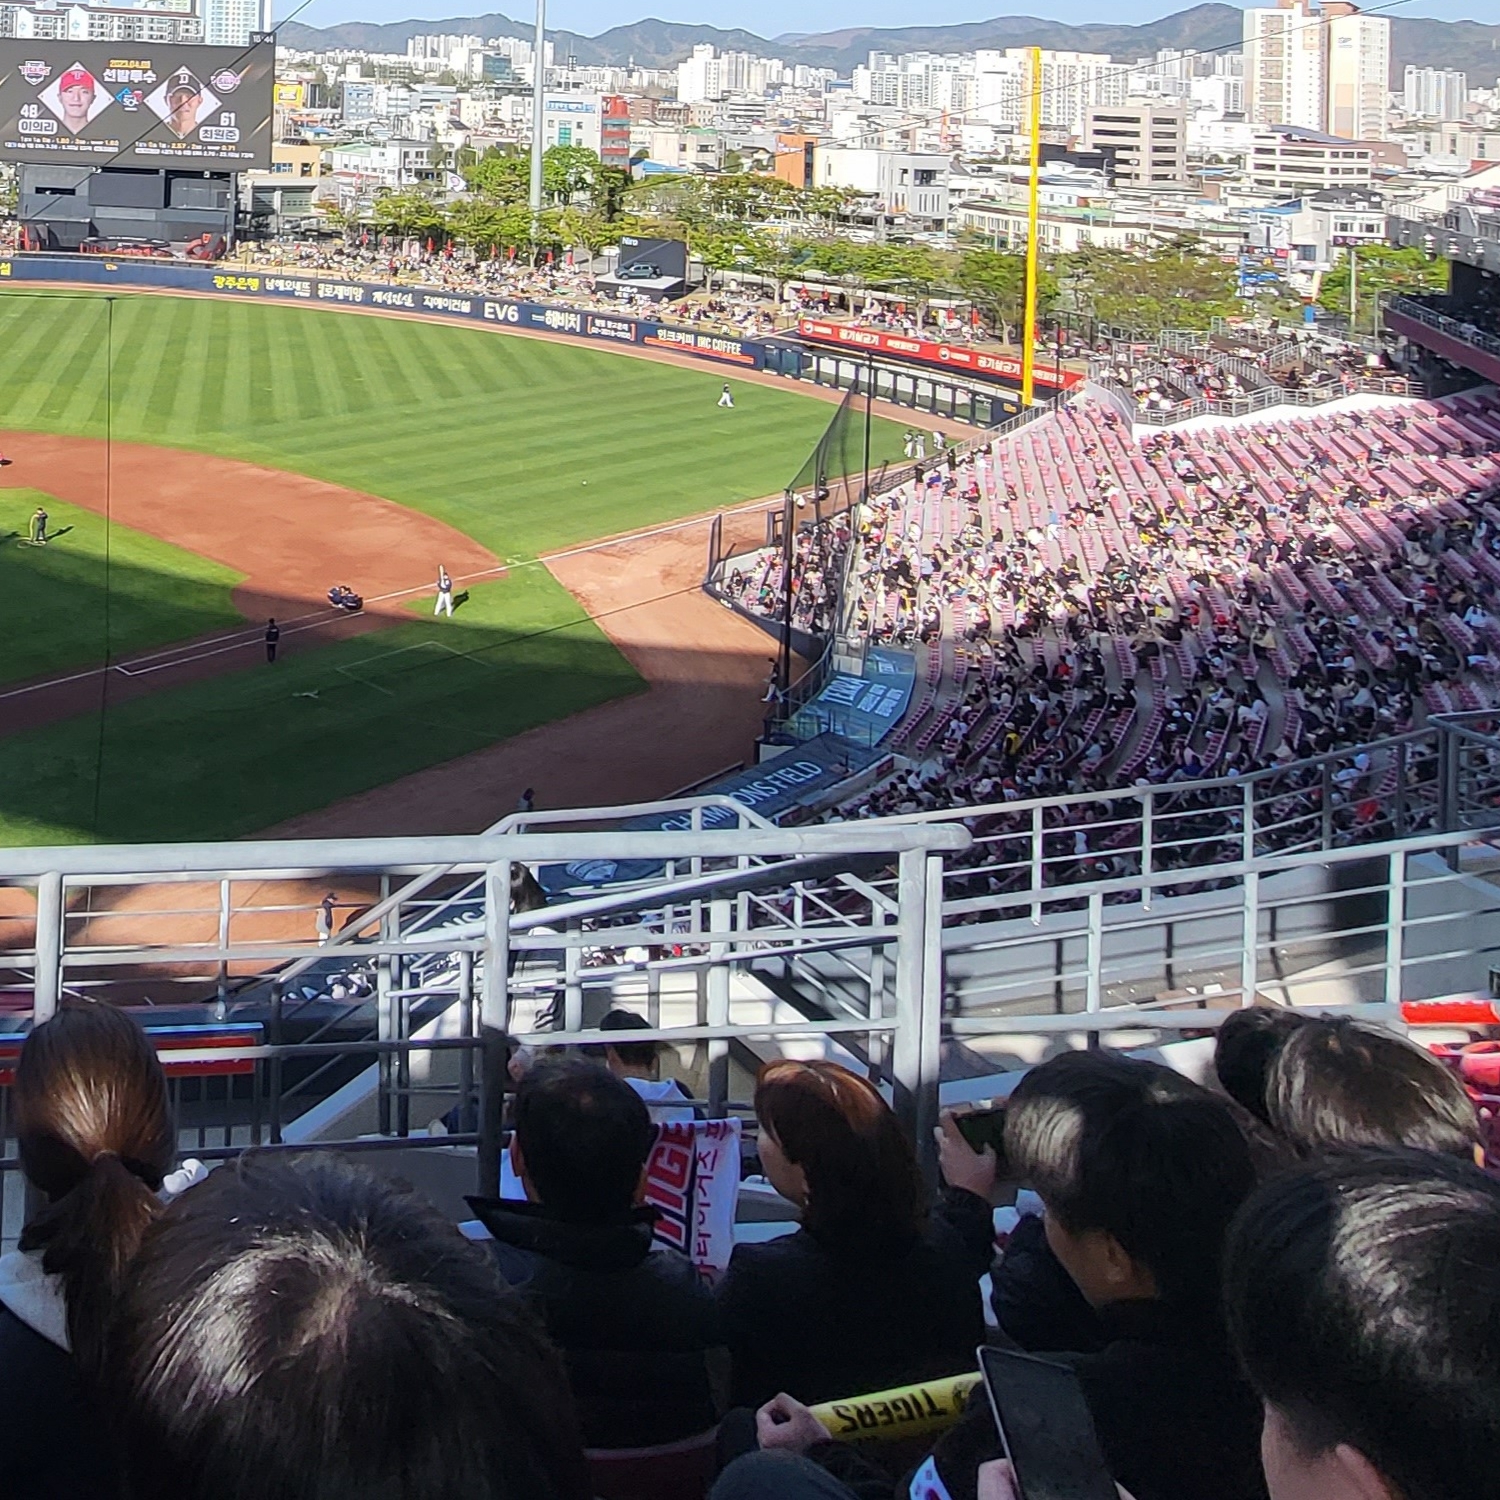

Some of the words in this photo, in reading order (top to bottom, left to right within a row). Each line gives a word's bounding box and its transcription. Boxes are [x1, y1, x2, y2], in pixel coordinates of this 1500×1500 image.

[102, 68, 157, 84] 선발투수
[20, 103, 39, 118] 48
[21, 120, 55, 133] 이의리
[219, 112, 236, 127] 61
[201, 128, 237, 141] 최원준
[622, 237, 639, 246] Niro
[212, 275, 260, 291] 광주은행
[483, 300, 520, 323] EV6
[544, 309, 581, 333] 해비치
[657, 329, 694, 347] 인크커피
[712, 338, 743, 356] COFFEE
[838, 328, 880, 346] 공기살균기
[977, 355, 1020, 376] 공기살균기
[764, 761, 823, 789] FIELD
[831, 1387, 949, 1434] TIGERS
